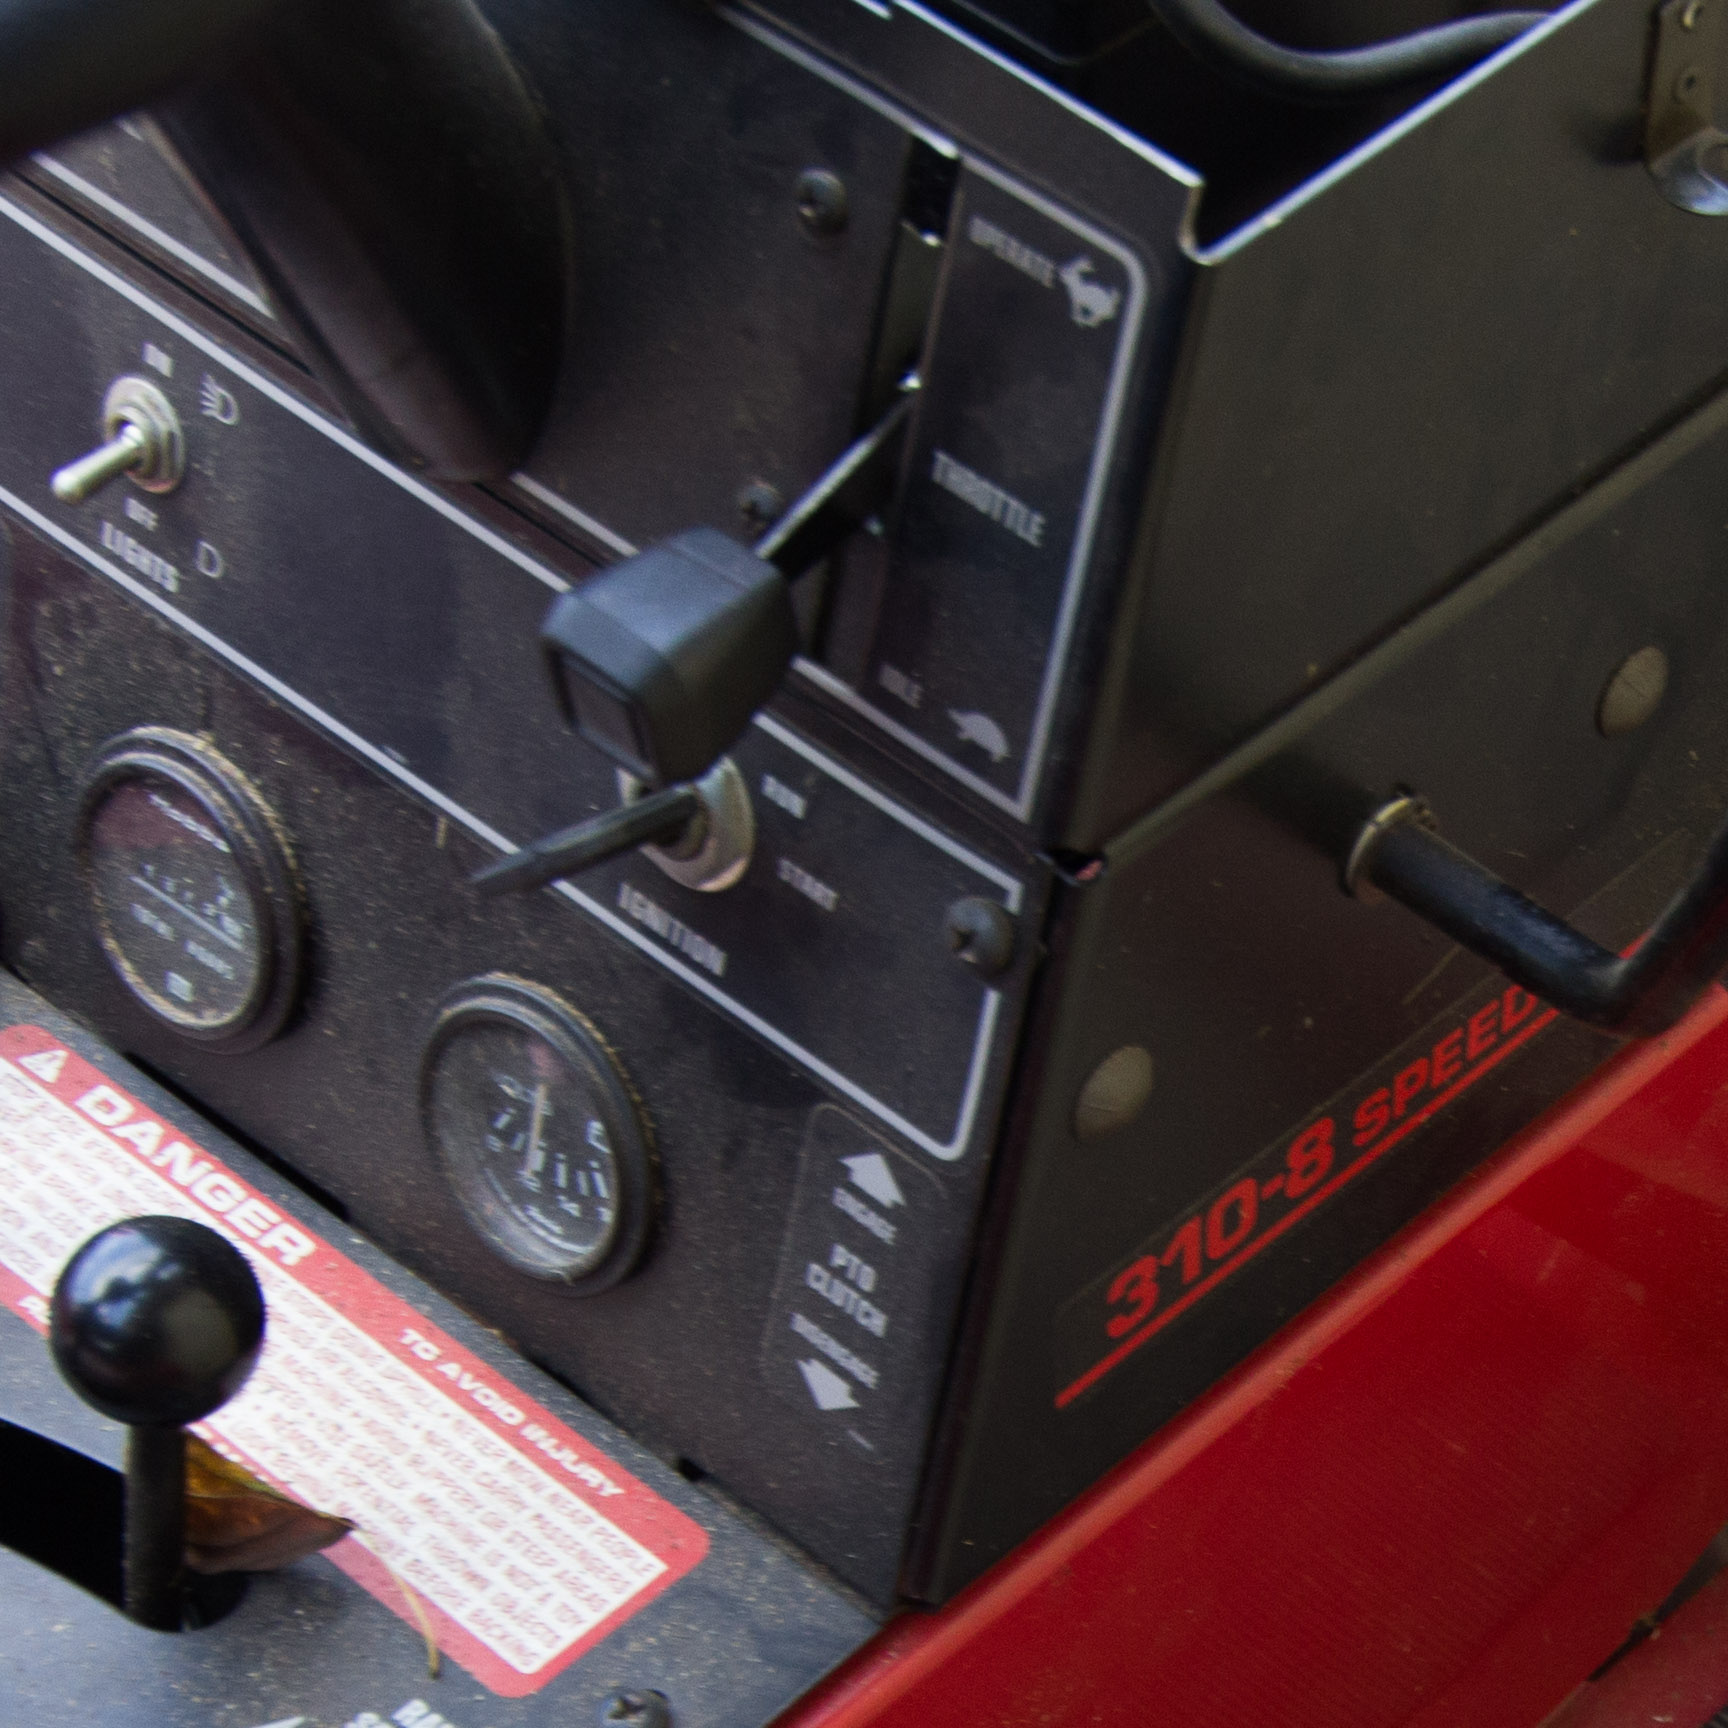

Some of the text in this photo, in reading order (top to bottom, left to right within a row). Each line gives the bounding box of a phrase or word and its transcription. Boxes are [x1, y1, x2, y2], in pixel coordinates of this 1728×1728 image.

[932, 450, 1045, 548] THROTTLE
[619, 881, 727, 977] IGNITION
[829, 1242, 876, 1293] PTO
[1107, 1118, 1335, 1338] 310-8
[72, 1082, 317, 1267] DANGER
[396, 1328, 444, 1364] TO
[433, 1356, 527, 1427] AVOID
[519, 1422, 625, 1502] INJURY
[805, 1262, 887, 1338] CLUTCH
[588, 1526, 652, 1575] PEOPLE
